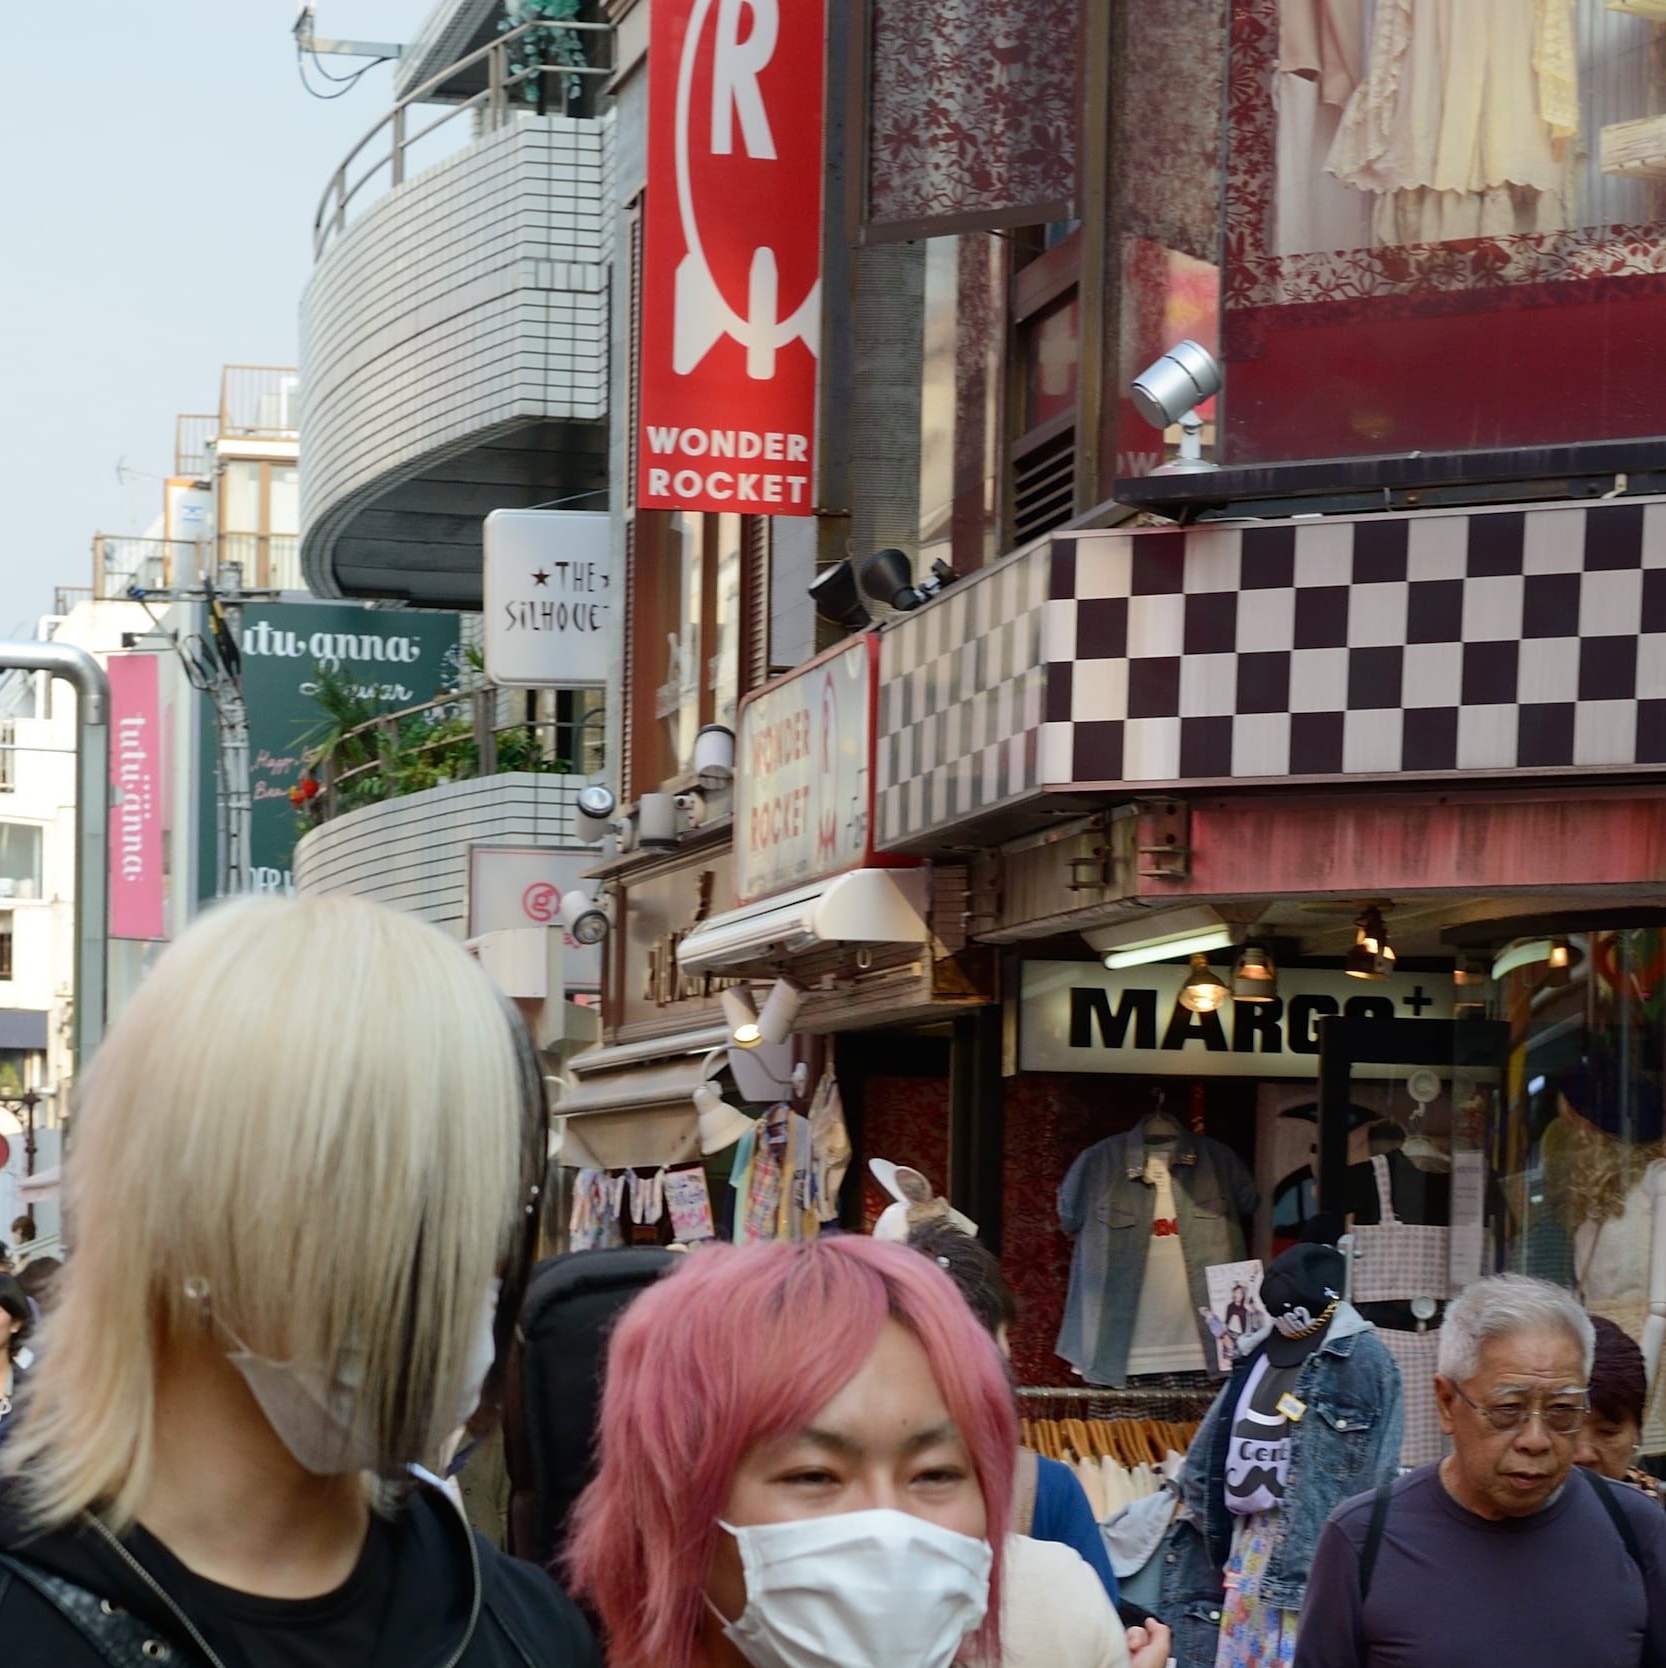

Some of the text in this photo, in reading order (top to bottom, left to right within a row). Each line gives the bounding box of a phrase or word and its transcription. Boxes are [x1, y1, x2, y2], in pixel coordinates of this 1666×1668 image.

[646, 426, 808, 462] WONDER
[648, 469, 808, 503] ROCKET
[555, 561, 595, 593] THE
[753, 708, 811, 779] WONDER
[750, 784, 810, 852] ROCKET
